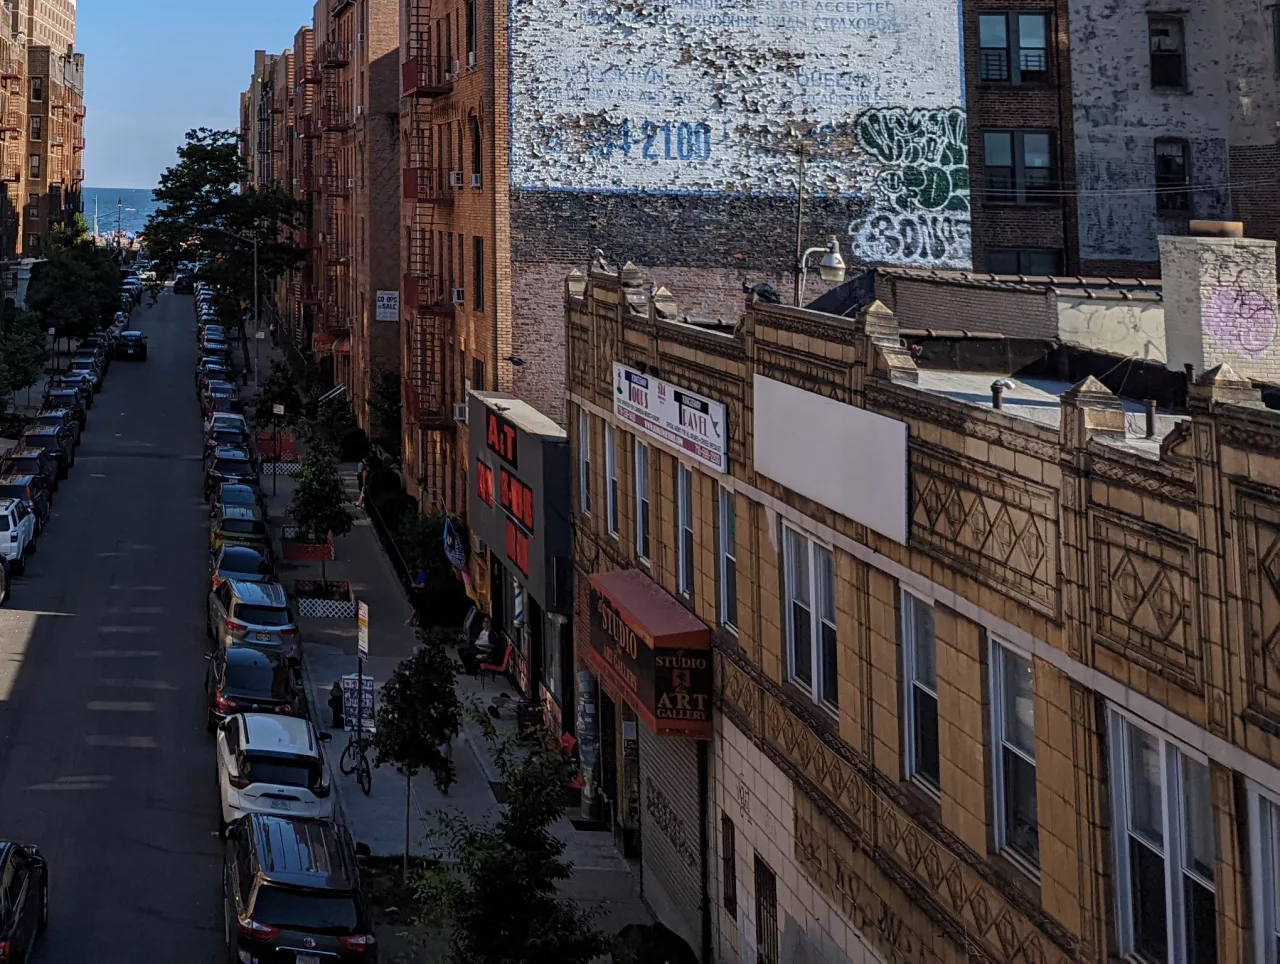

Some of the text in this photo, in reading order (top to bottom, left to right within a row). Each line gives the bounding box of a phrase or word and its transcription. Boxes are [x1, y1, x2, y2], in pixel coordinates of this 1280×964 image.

[679, 0, 775, 12] INSURES
[814, 1, 896, 14] ACCEPTED
[674, 390, 708, 437] TRAVEL
[601, 603, 638, 660] STUDIO
[655, 656, 707, 669] STUDIO
[657, 693, 708, 710] ART
[657, 709, 707, 720] GALLERY
